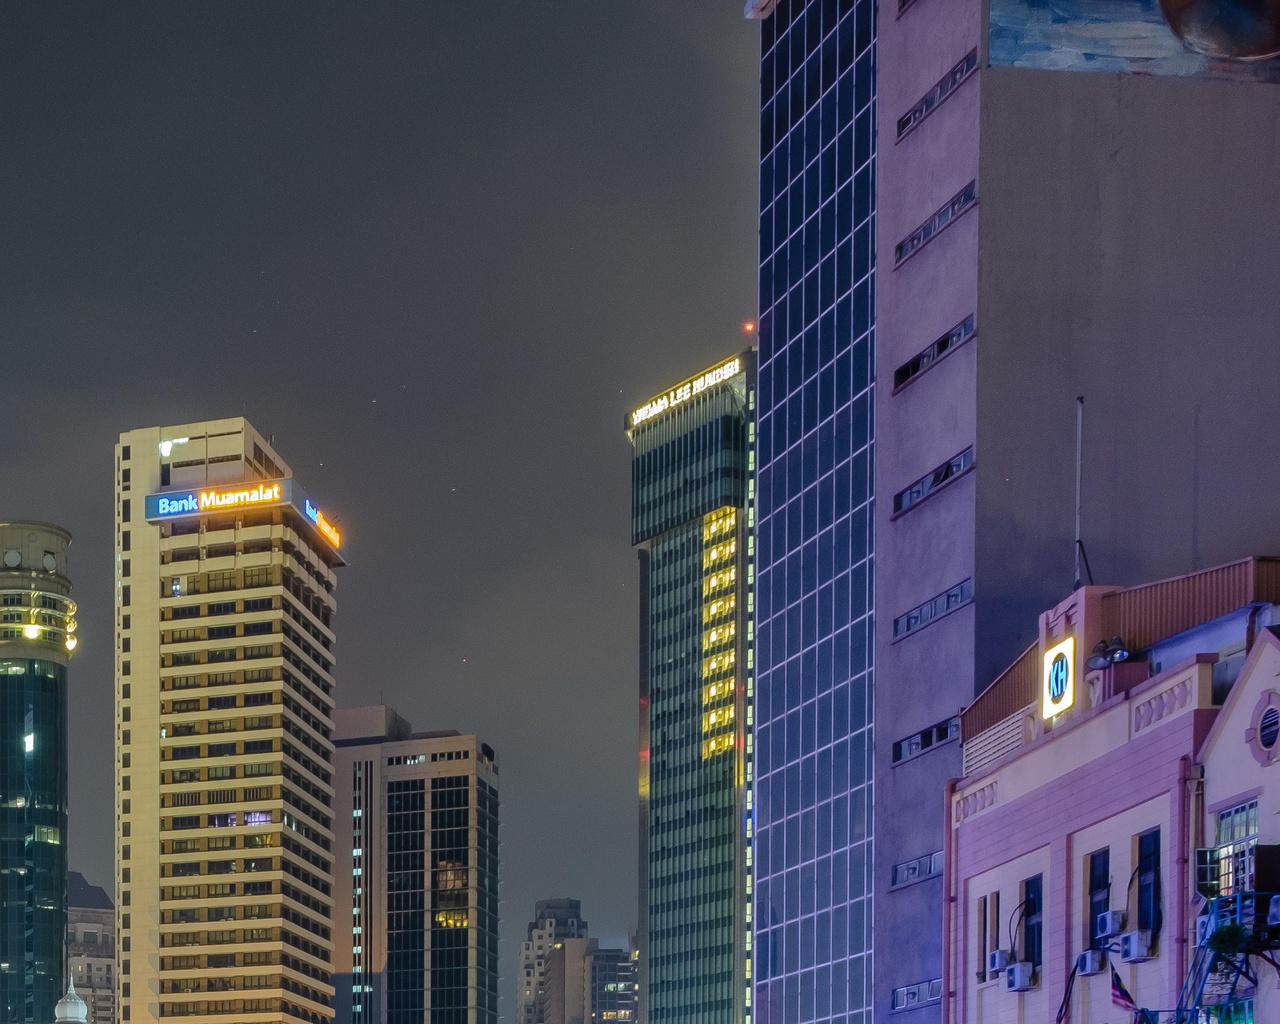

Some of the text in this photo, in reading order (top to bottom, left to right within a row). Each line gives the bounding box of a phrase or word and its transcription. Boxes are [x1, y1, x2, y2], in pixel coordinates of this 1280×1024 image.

[670, 382, 692, 407] LEE
[158, 484, 280, 514] Bank Muamalat
[1050, 657, 1067, 699] KH
